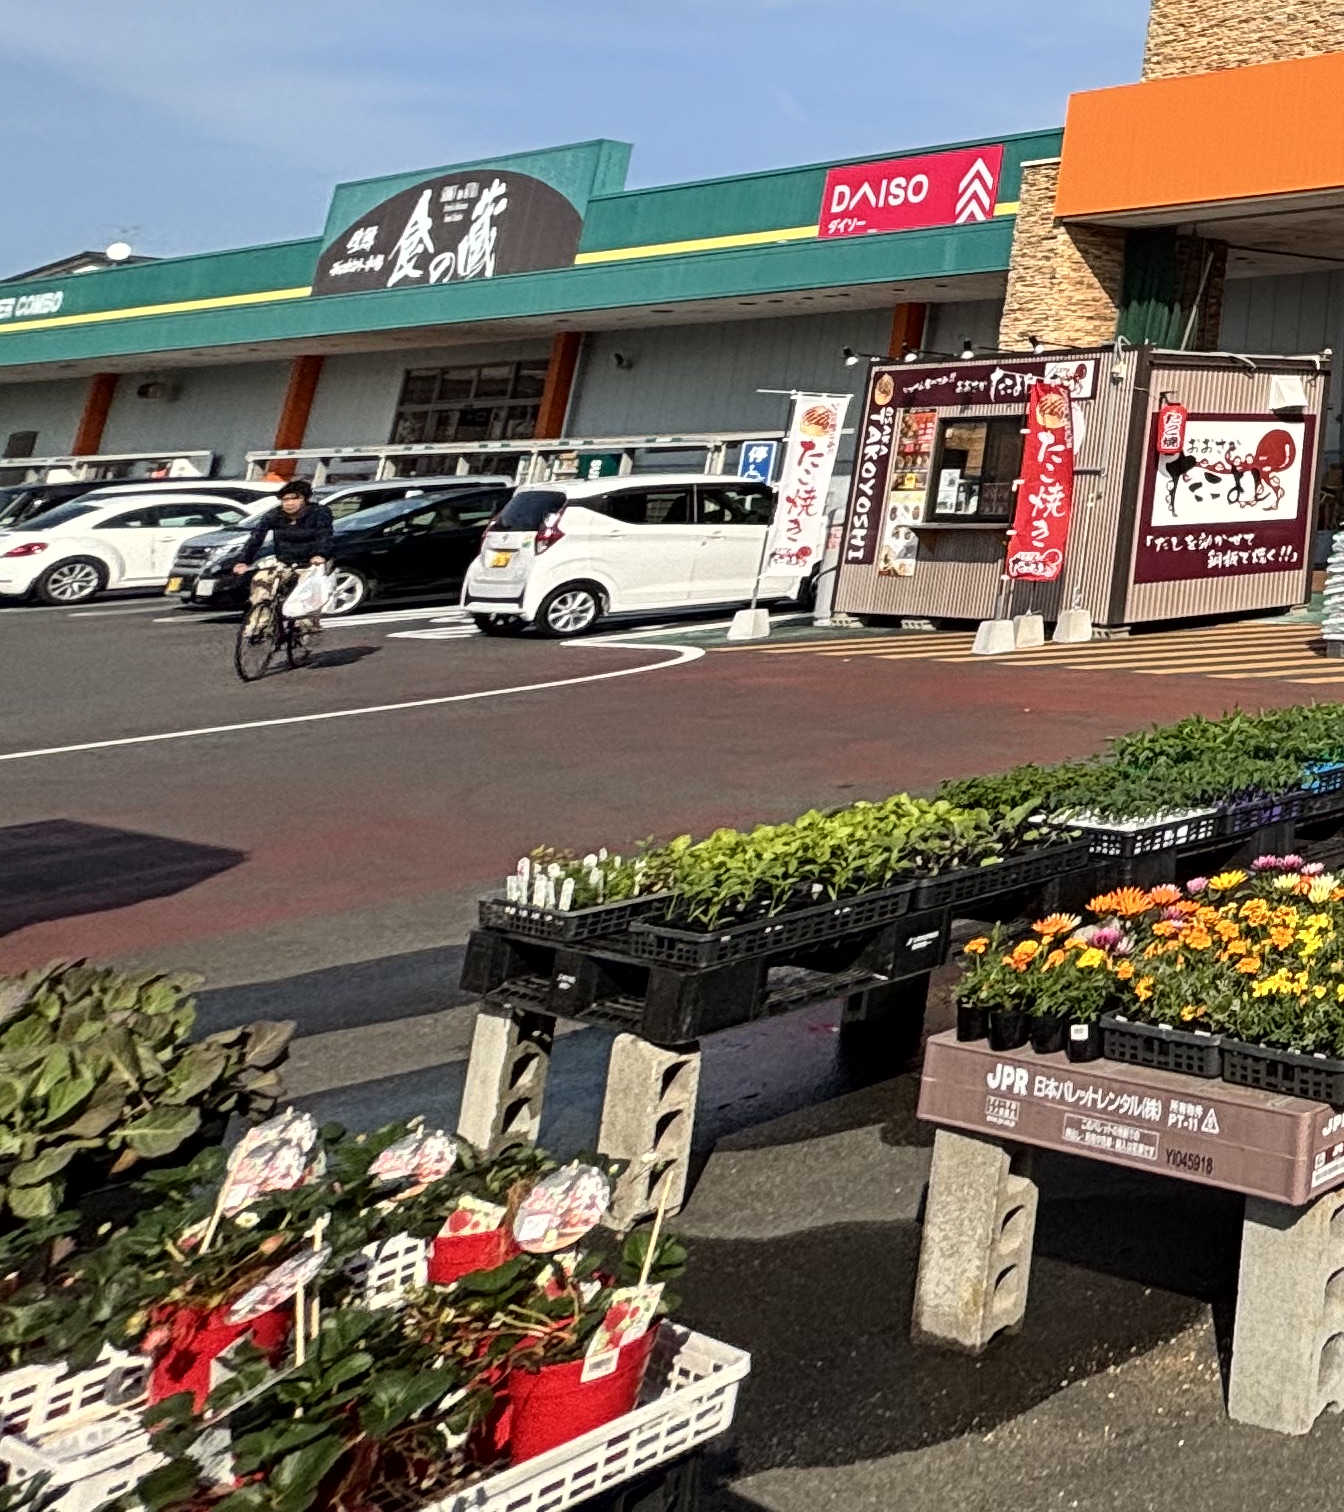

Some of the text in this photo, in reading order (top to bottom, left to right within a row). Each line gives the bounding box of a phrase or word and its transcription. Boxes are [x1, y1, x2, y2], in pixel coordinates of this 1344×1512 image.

[830, 174, 929, 213] DAISO
[785, 439, 825, 542] たこ焼き
[848, 407, 886, 561] TAKOYOSHI
[1028, 431, 1067, 547] たこ焼き
[986, 1063, 1029, 1096] JPR
